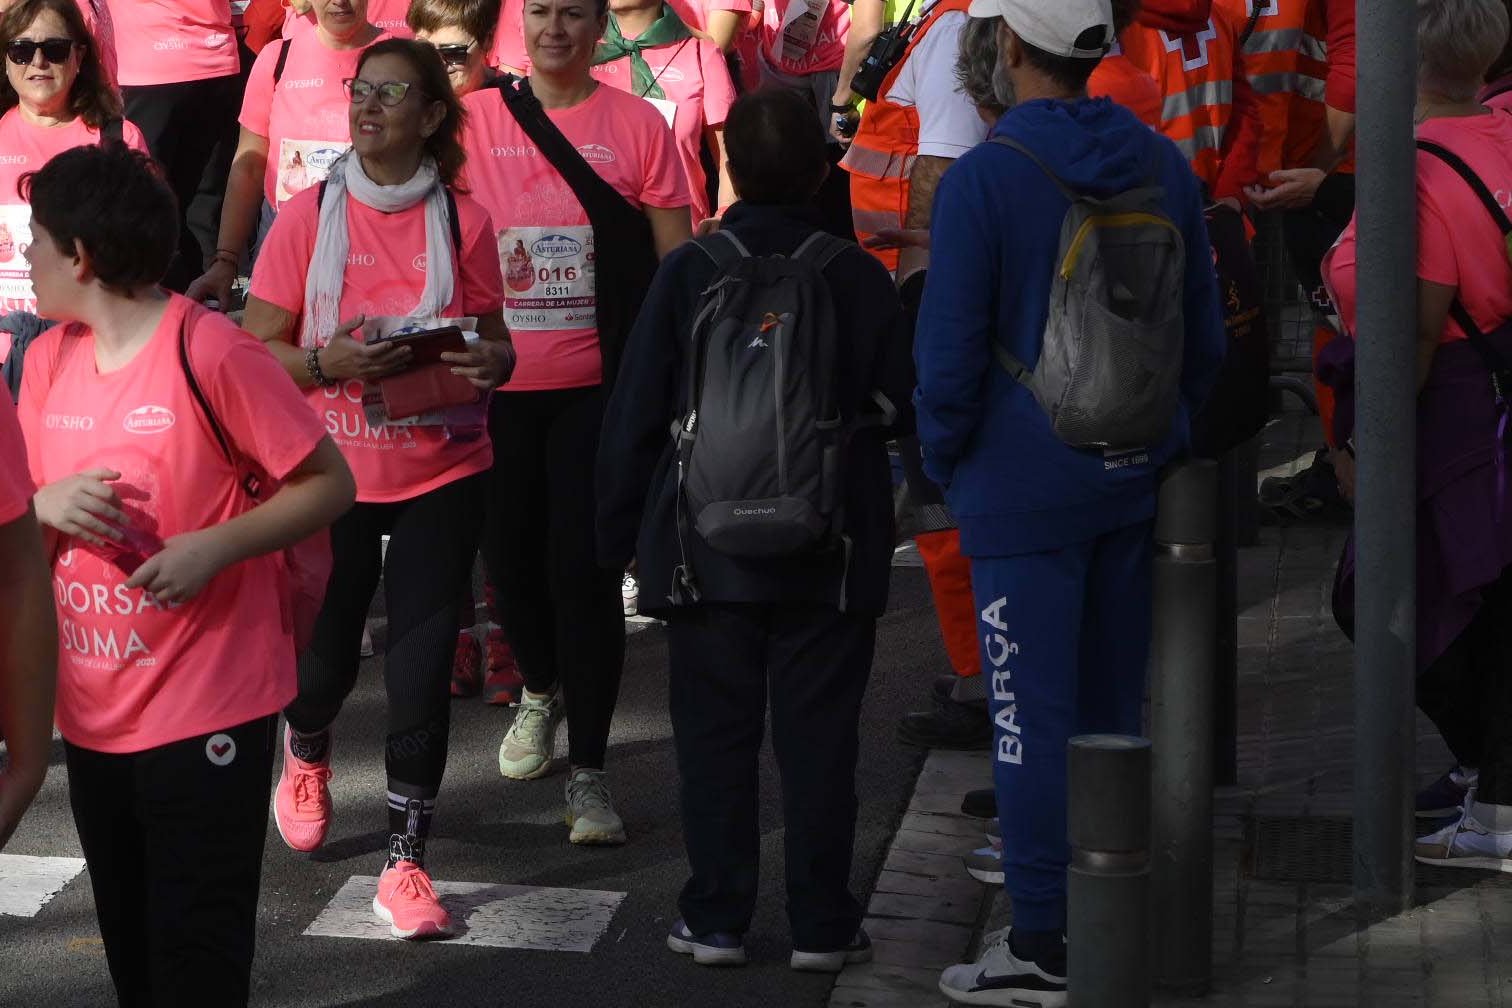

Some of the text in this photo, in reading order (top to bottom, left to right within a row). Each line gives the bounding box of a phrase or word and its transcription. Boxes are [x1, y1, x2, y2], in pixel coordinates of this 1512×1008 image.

[284, 77, 325, 90] OYSHO
[490, 146, 537, 158] OYSHO
[534, 243, 579, 256] ASTURIANA
[538, 266, 578, 283] 016
[544, 286, 570, 296] 8311
[514, 299, 545, 308] CARRERA
[567, 298, 590, 306] MUJER
[512, 313, 547, 323] OYSHO
[45, 412, 95, 432] OYSHO
[126, 414, 172, 430] ASTURIANA
[1104, 457, 1130, 471] SINCE
[733, 506, 777, 516] Quechua
[55, 575, 182, 617] DORSA
[61, 618, 152, 661] SUMA
[981, 596, 1023, 767] BARÇA
